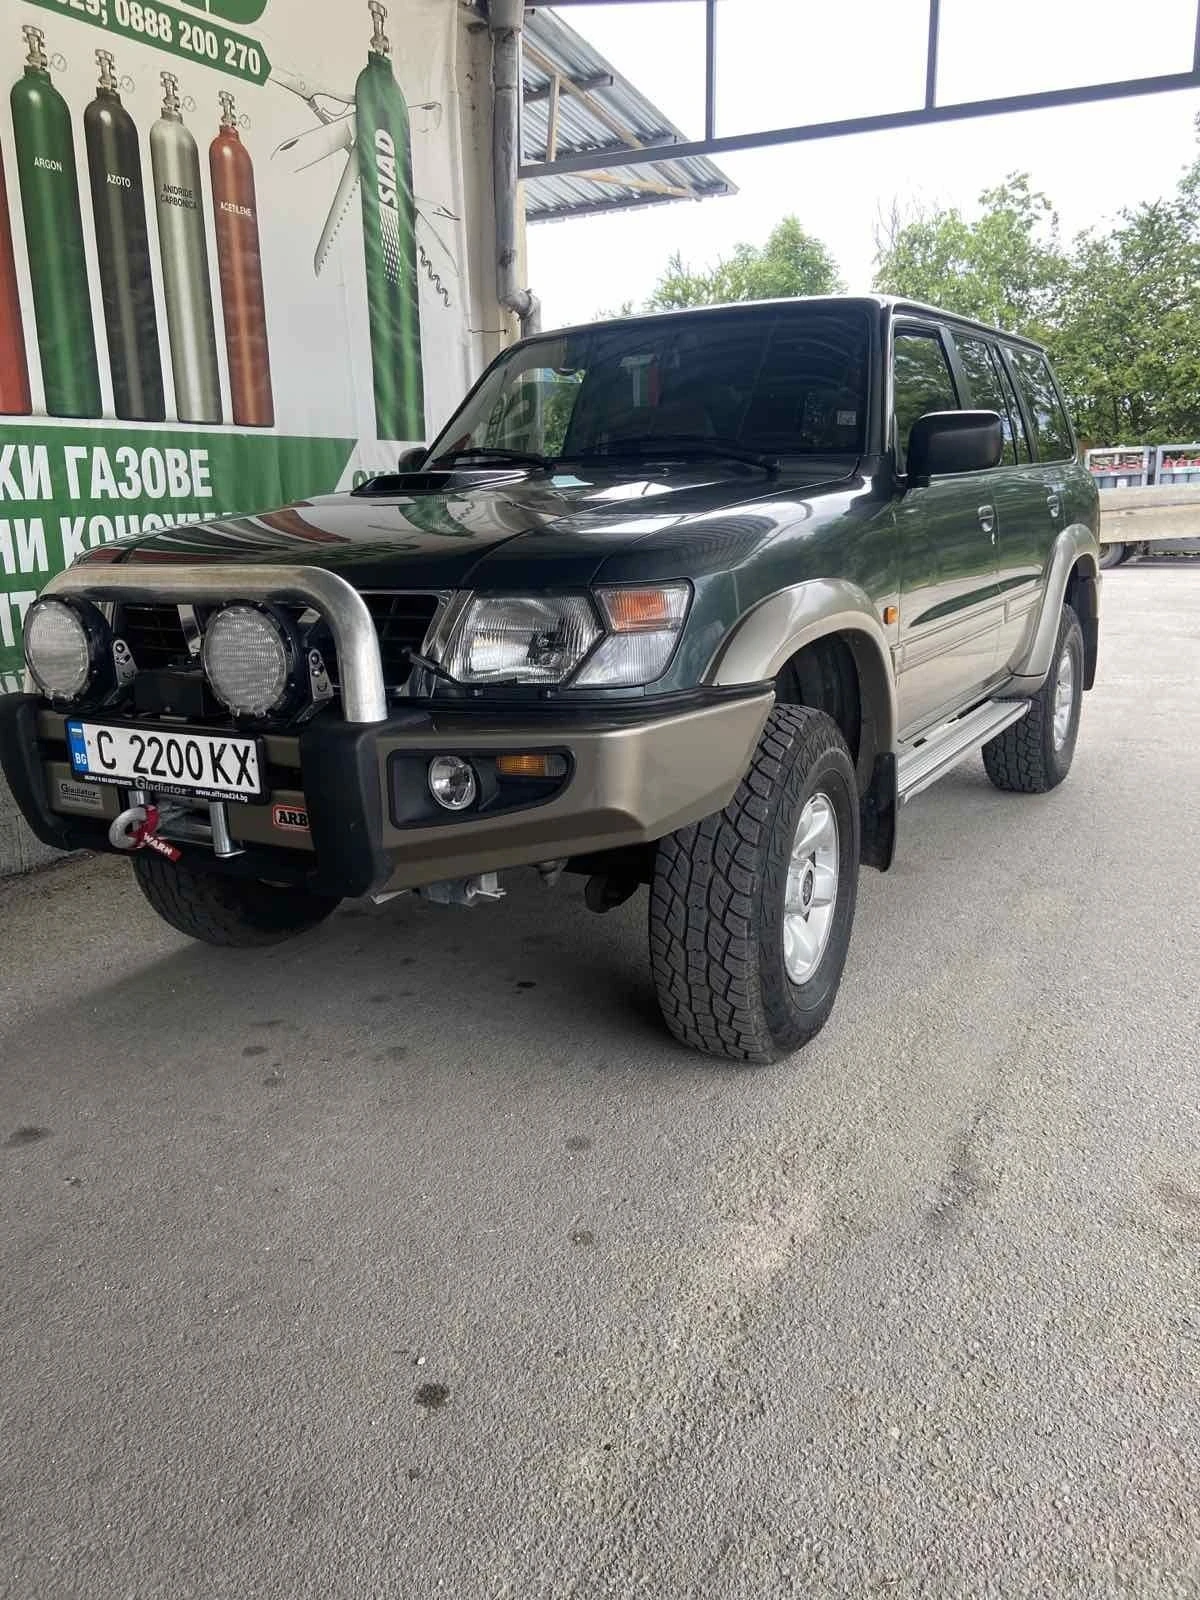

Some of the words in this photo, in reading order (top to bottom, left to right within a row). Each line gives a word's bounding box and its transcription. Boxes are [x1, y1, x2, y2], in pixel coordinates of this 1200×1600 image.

[115, 0, 173, 43] 0888
[178, 20, 218, 60] 200
[224, 37, 261, 75] 270
[34, 156, 63, 173] ARGON
[375, 129, 399, 210] SIAD
[106, 173, 132, 189] AZOTO
[163, 183, 193, 199] ANIDRIDE
[63, 446, 213, 499] ГАЗОВЕ
[75, 752, 88, 765] BG
[129, 735, 204, 781] 2200
[209, 742, 255, 788] KX
[278, 810, 309, 827] ARB
[143, 832, 173, 856] WARN
